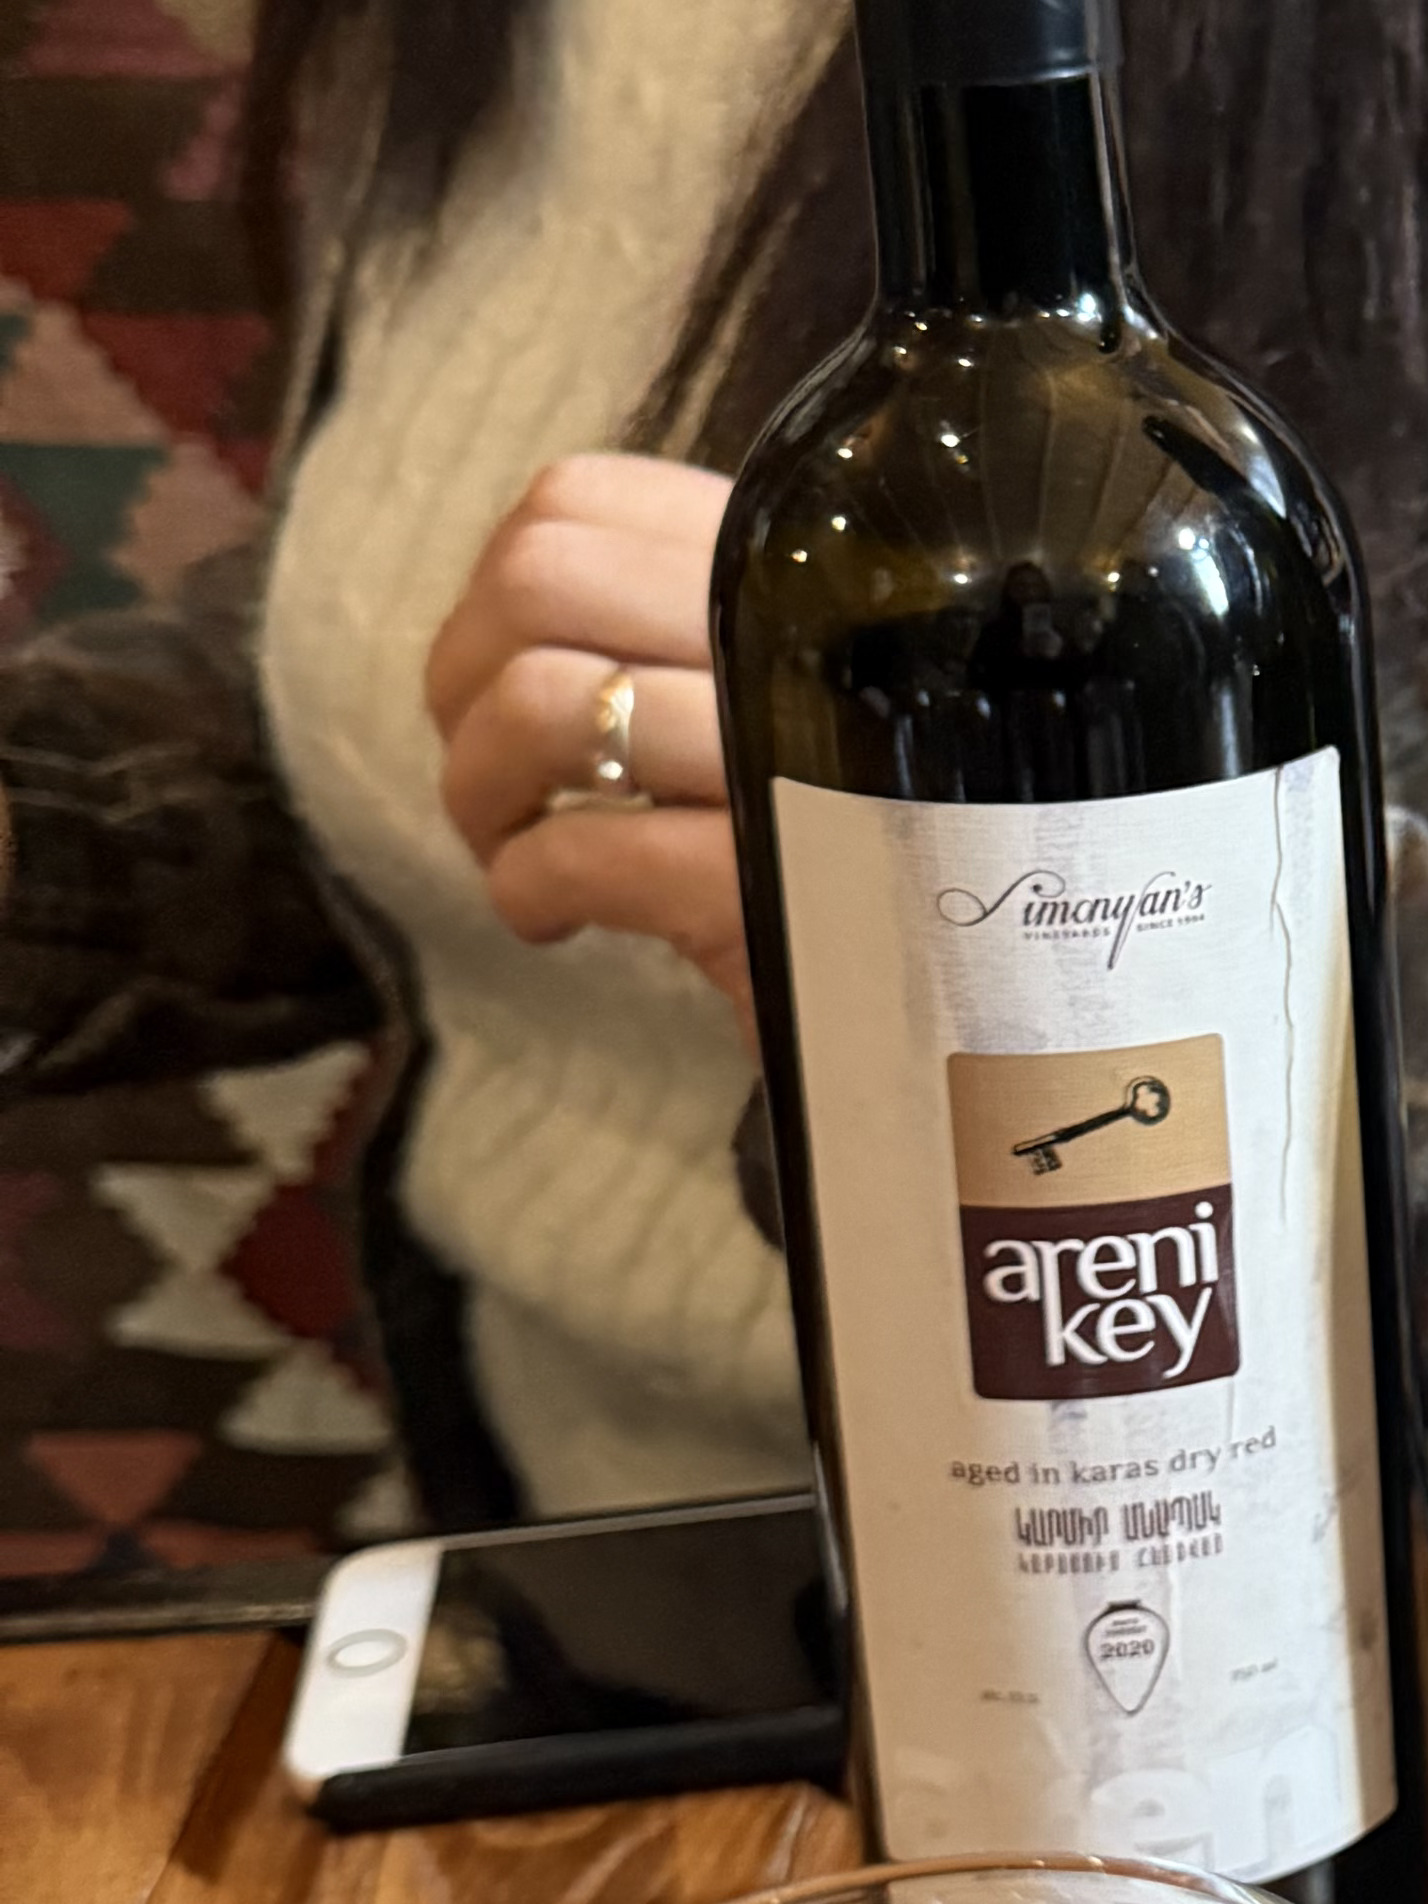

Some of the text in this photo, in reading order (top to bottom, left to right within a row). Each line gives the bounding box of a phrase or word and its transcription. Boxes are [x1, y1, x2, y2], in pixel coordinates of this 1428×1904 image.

[984, 1200, 1219, 1303] areni
[1043, 1287, 1213, 1379] key
[951, 1425, 1277, 1486] aged in karas dry red
[1101, 1639, 1155, 1659] 2020
